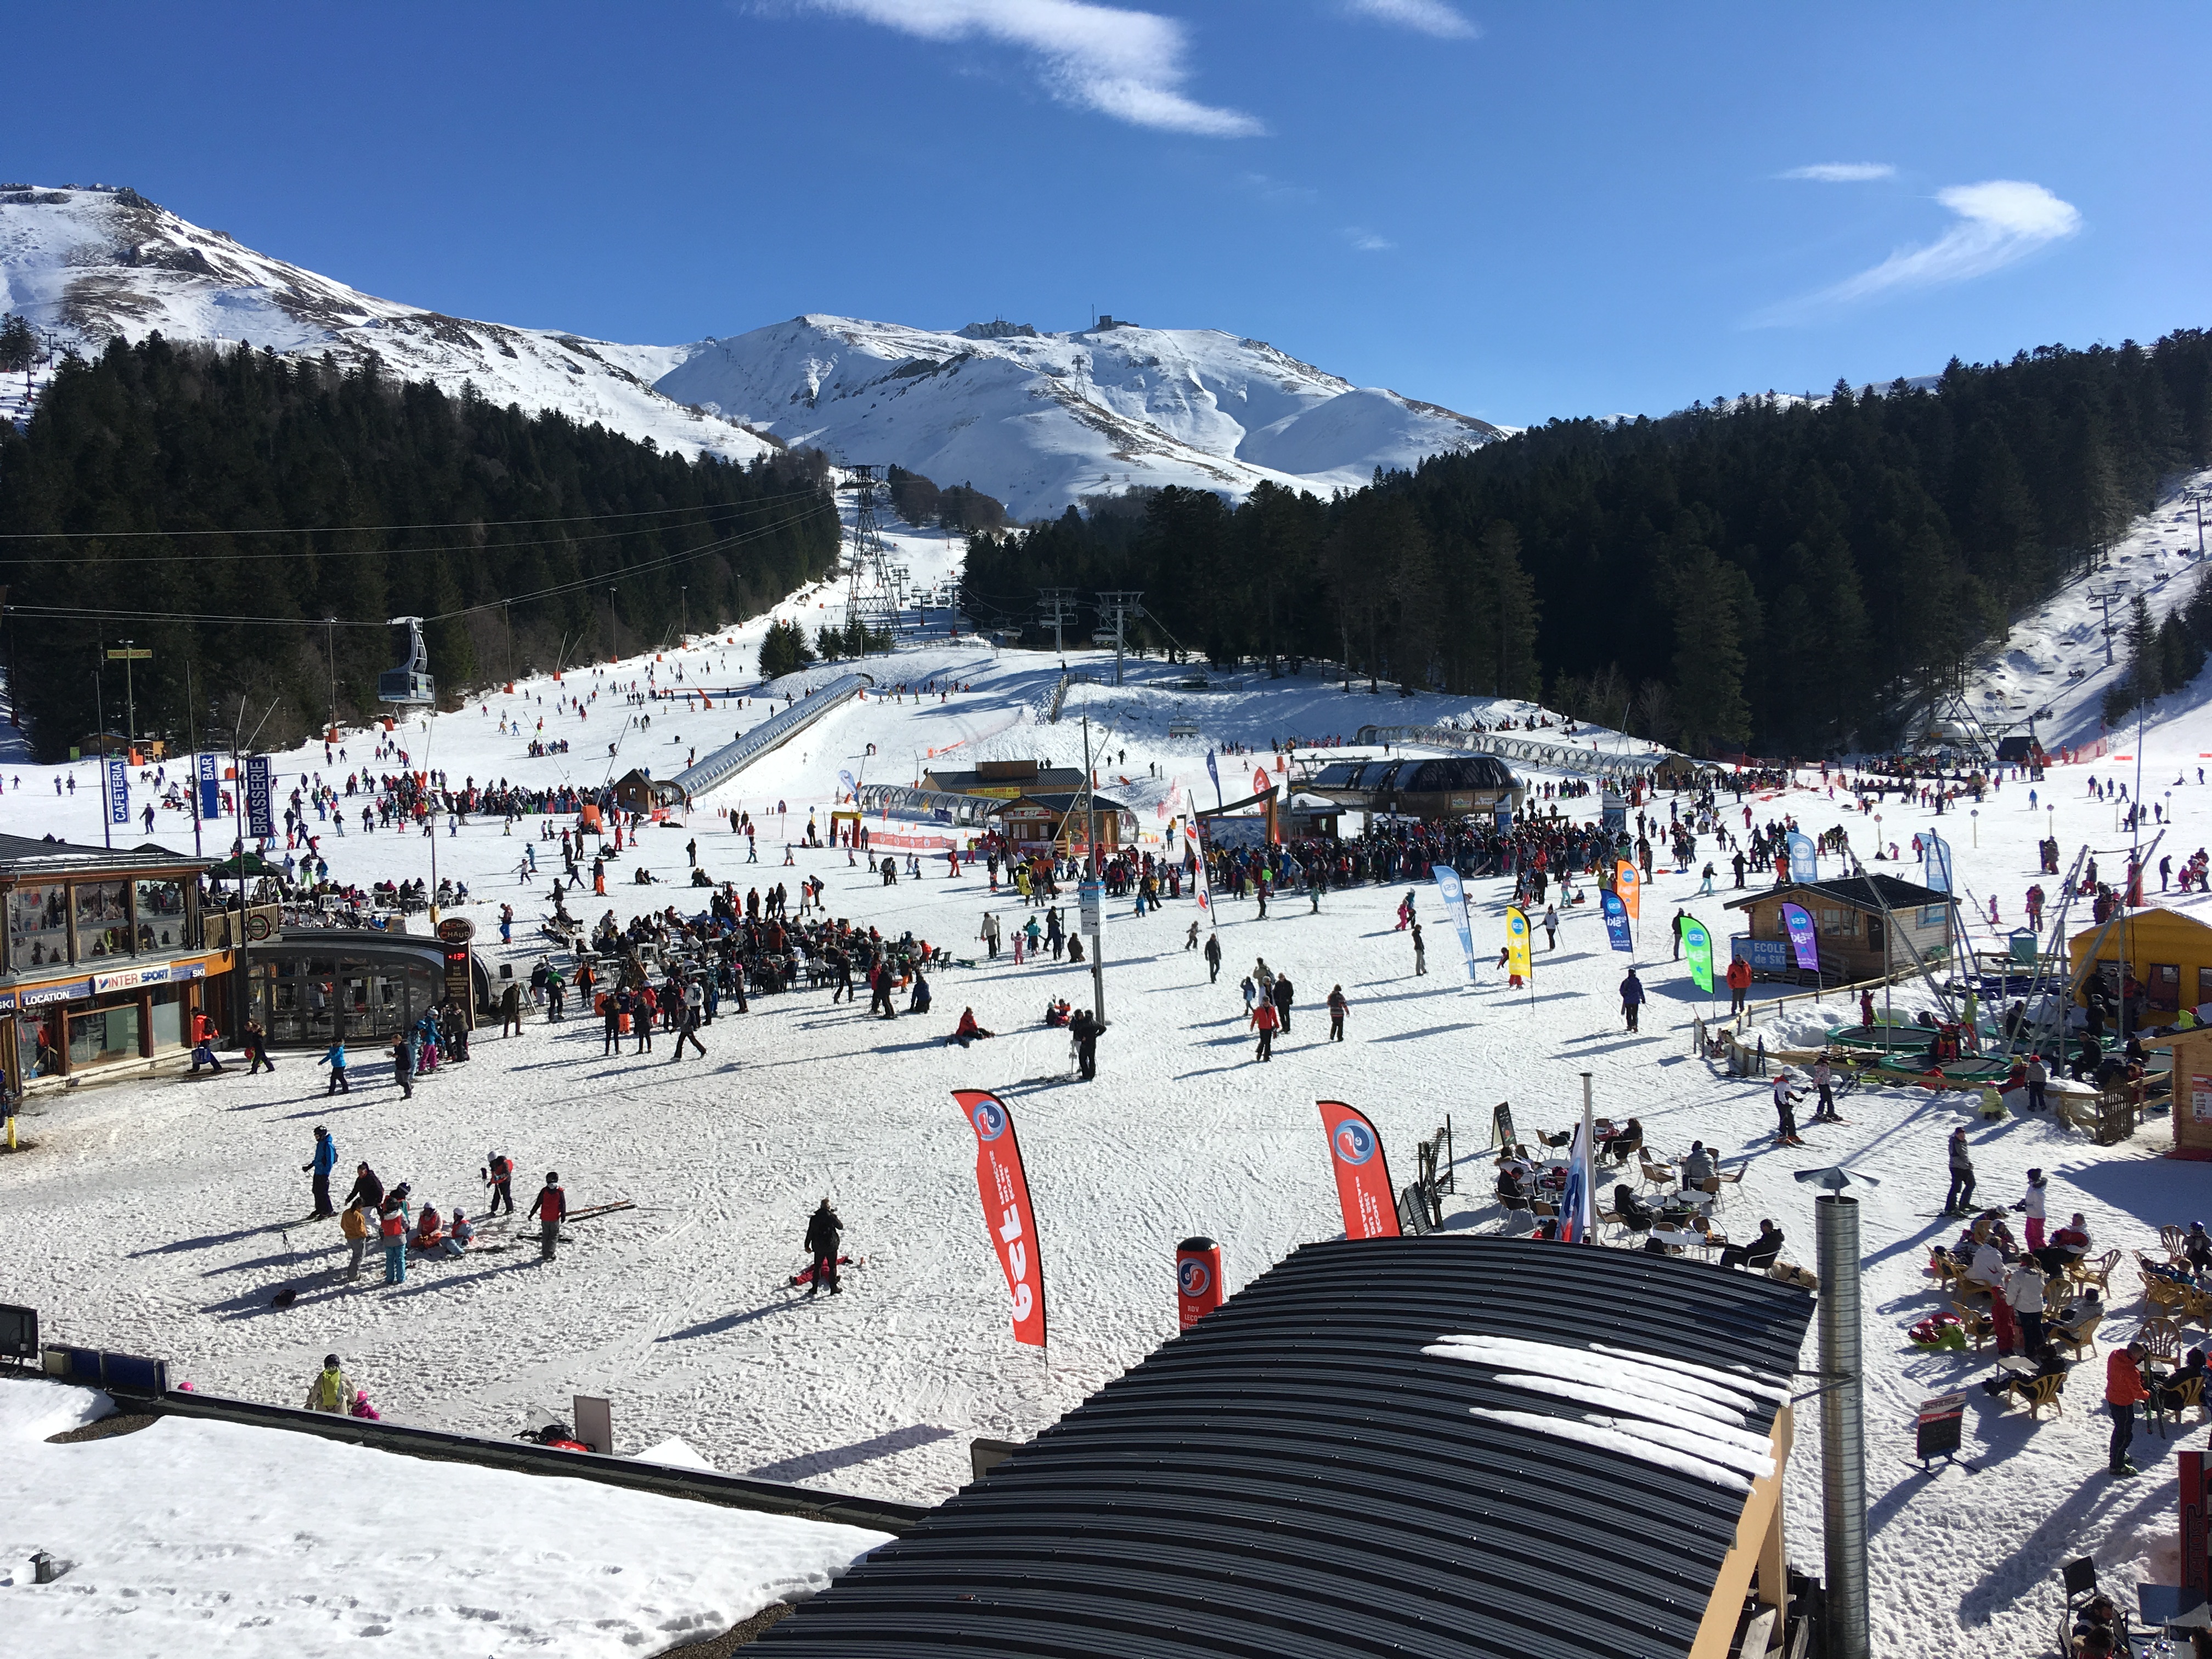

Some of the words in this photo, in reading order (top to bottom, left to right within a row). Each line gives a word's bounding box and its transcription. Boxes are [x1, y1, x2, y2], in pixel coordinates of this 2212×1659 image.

[202, 757, 214, 781] BAR
[111, 763, 126, 821] CAFETERIA
[249, 761, 268, 834] BRASSERIE
[1787, 894, 1810, 902] ESI
[440, 931, 470, 939] CHAUD
[1754, 943, 1786, 953] ECOLE
[1756, 955, 1765, 964] de
[1769, 955, 1786, 964] SKI
[109, 973, 138, 988] INTER
[140, 968, 170, 983] SPORT
[192, 968, 205, 978] SKI
[25, 991, 70, 1006] LOCATION
[0, 999, 14, 1009] SKI
